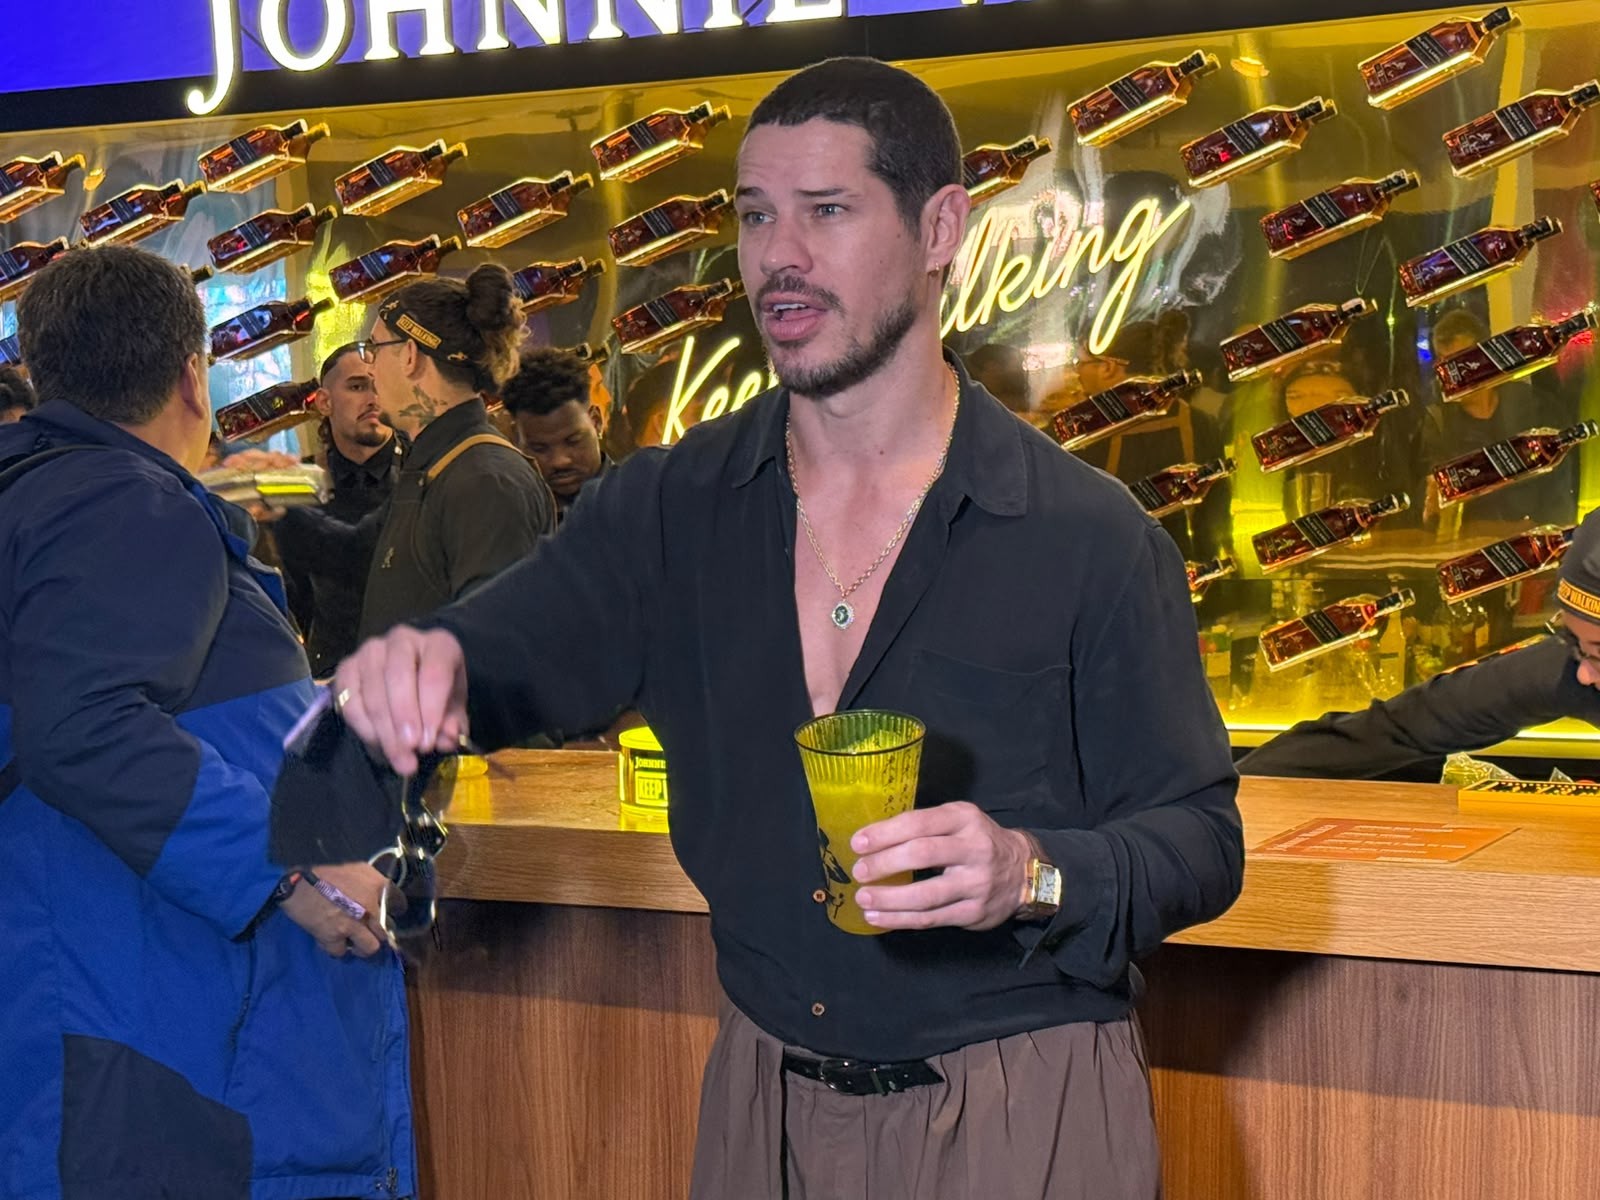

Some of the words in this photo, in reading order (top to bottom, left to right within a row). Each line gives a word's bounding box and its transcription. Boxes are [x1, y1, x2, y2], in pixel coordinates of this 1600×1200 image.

[186, 0, 843, 115] JOHN
[661, 335, 780, 446] Kee
[940, 198, 1191, 355] lking
[1570, 590, 1600, 616] WALKIN
